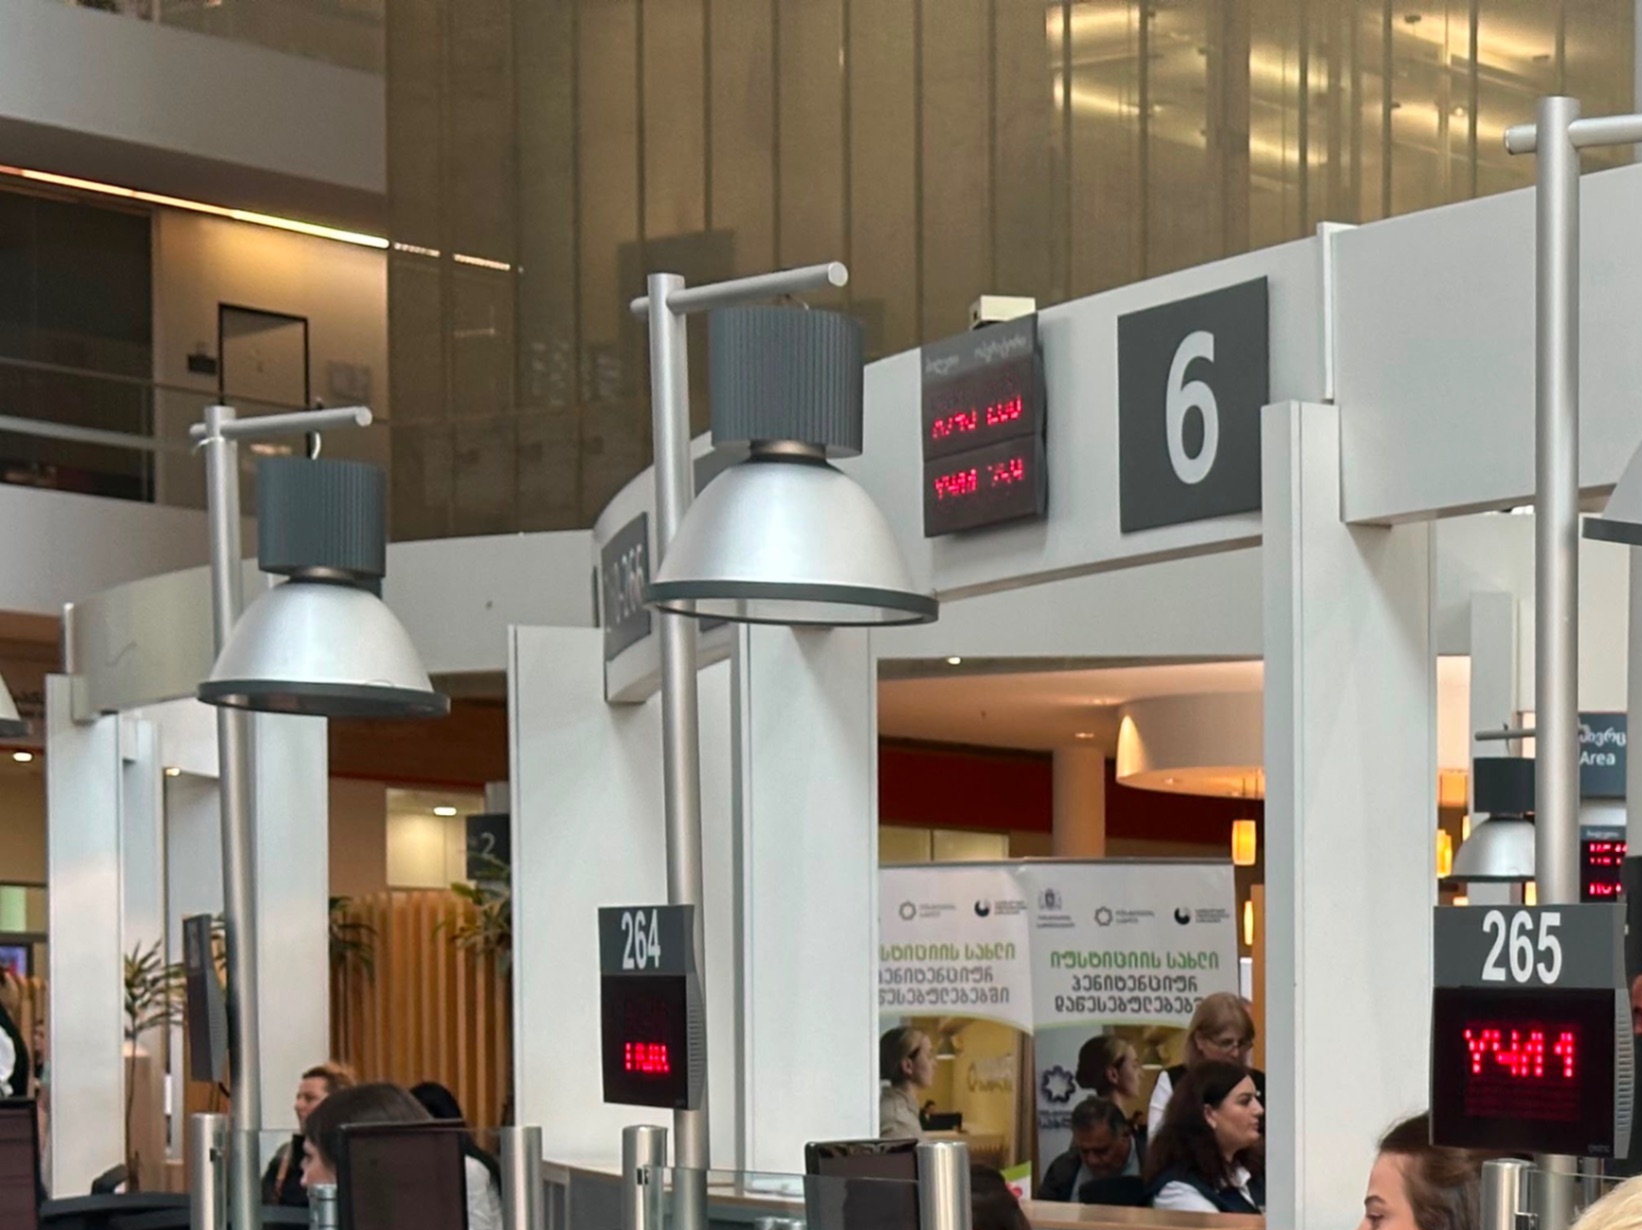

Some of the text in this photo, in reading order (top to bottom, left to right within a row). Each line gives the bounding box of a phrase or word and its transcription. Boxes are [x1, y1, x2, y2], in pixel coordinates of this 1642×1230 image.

[1166, 330, 1220, 485] 6
[1579, 751, 1616, 765] Area
[621, 909, 661, 969] 264
[1481, 909, 1562, 984] 265
[880, 943, 959, 962] სტიციის
[1050, 951, 1219, 969] იუსტიციის სახლი
[879, 966, 993, 984] ენიტენციურ
[879, 987, 1010, 1005] წესებულებებში
[1055, 995, 1203, 1014] დაწესებულებებ
